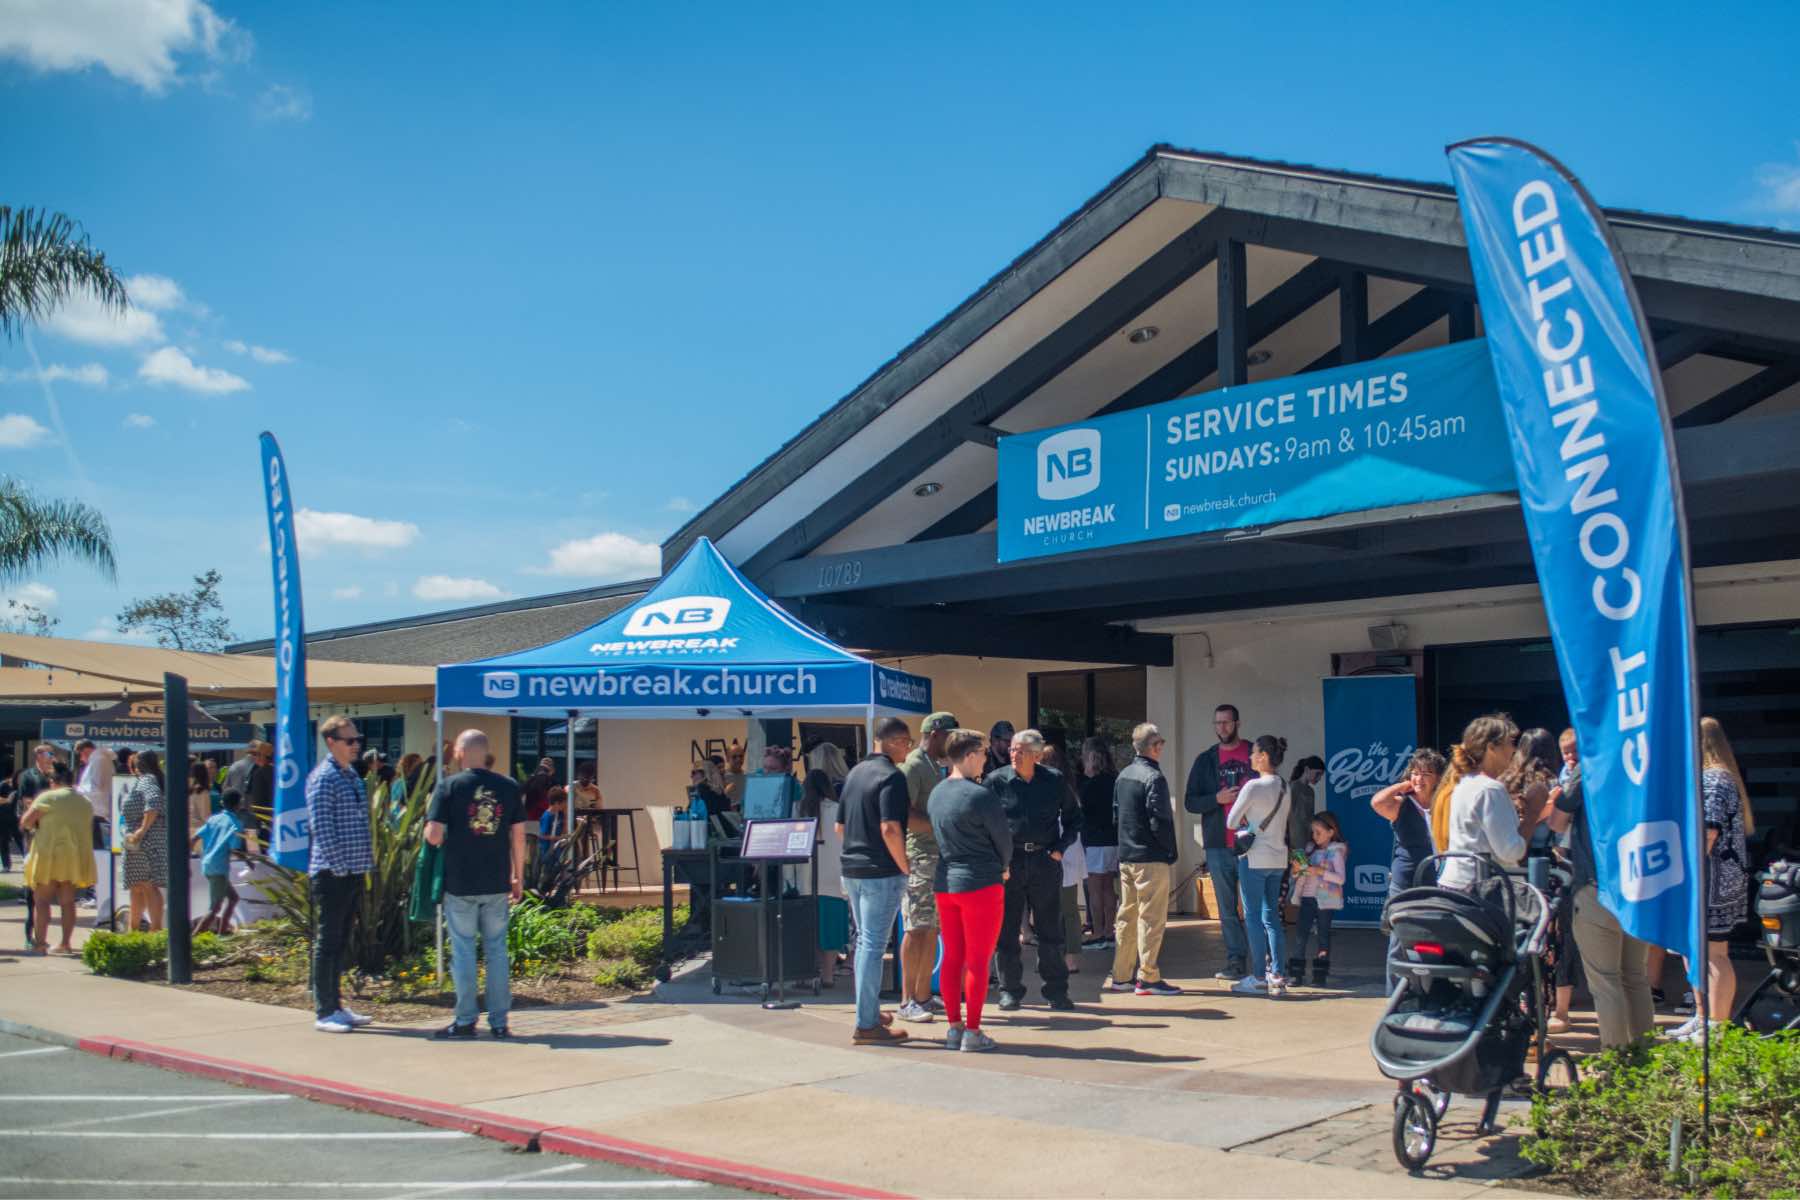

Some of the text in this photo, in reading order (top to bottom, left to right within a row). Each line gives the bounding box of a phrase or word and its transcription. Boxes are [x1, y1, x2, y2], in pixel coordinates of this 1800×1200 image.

[1166, 371, 1409, 445] SERVICE TIMES
[1165, 414, 1466, 482] SUNDAYS: 9am & 10:45am
[1046, 446, 1093, 483] NB
[1512, 179, 1649, 786] GET CONNECTED
[1182, 487, 1277, 515] newbreak.church
[1023, 503, 1117, 536] NEWBREAK
[1043, 530, 1094, 546] CHURCH
[642, 607, 714, 627] NB
[589, 637, 740, 652] NEWBREAK
[489, 668, 817, 697] NB newbreak.church
[1367, 741, 1389, 757] the
[1328, 745, 1415, 794] Best
[1359, 871, 1386, 885] NB
[1346, 895, 1385, 905] NEWBRE
